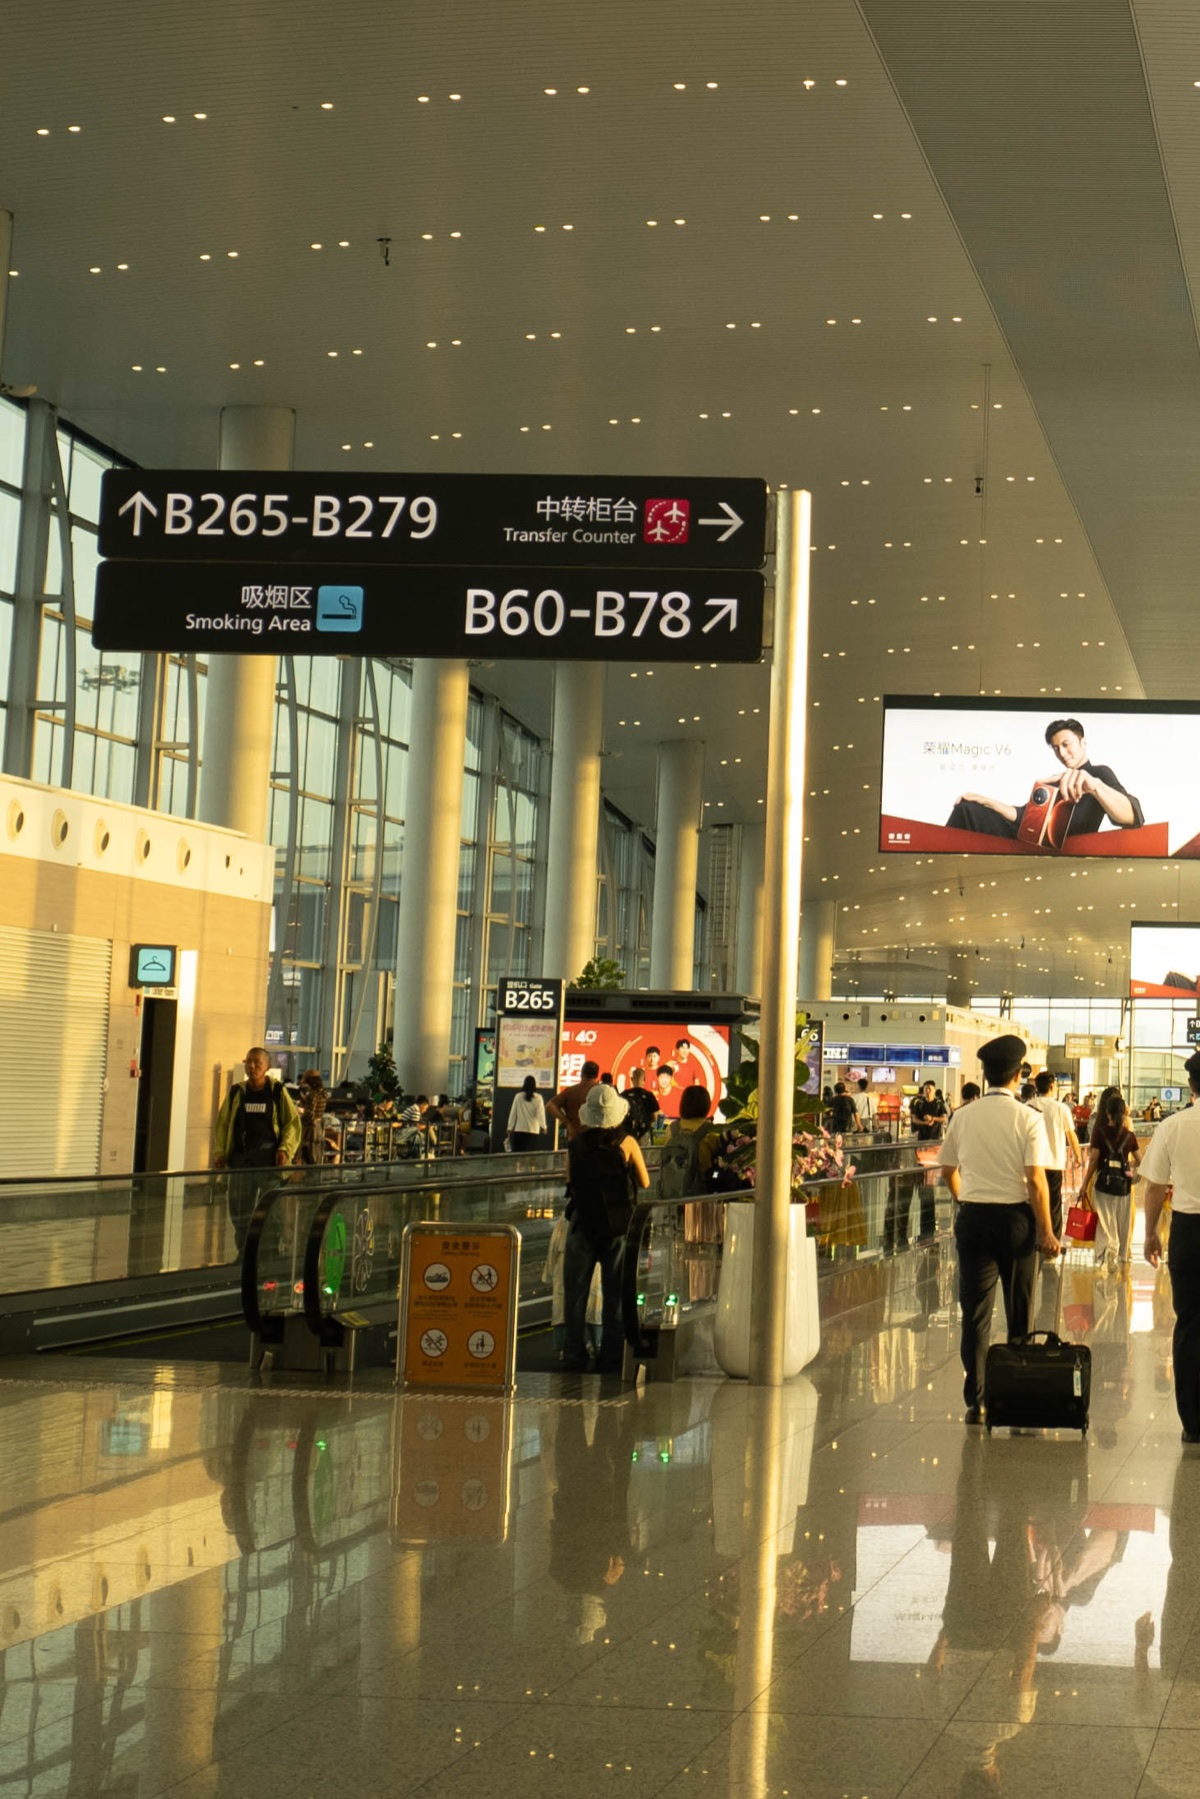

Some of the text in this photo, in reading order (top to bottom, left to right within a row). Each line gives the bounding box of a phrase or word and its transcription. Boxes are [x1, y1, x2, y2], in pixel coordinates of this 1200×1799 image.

[164, 493, 437, 539] B265-B279
[536, 496, 637, 522] 中转柜台
[503, 527, 636, 544] Transfer Counter
[241, 585, 313, 609] 吸烟区
[185, 614, 311, 634] Smoking Area
[465, 588, 691, 638] B60-B78
[994, 743, 1012, 756] V6
[505, 991, 554, 1009] B265
